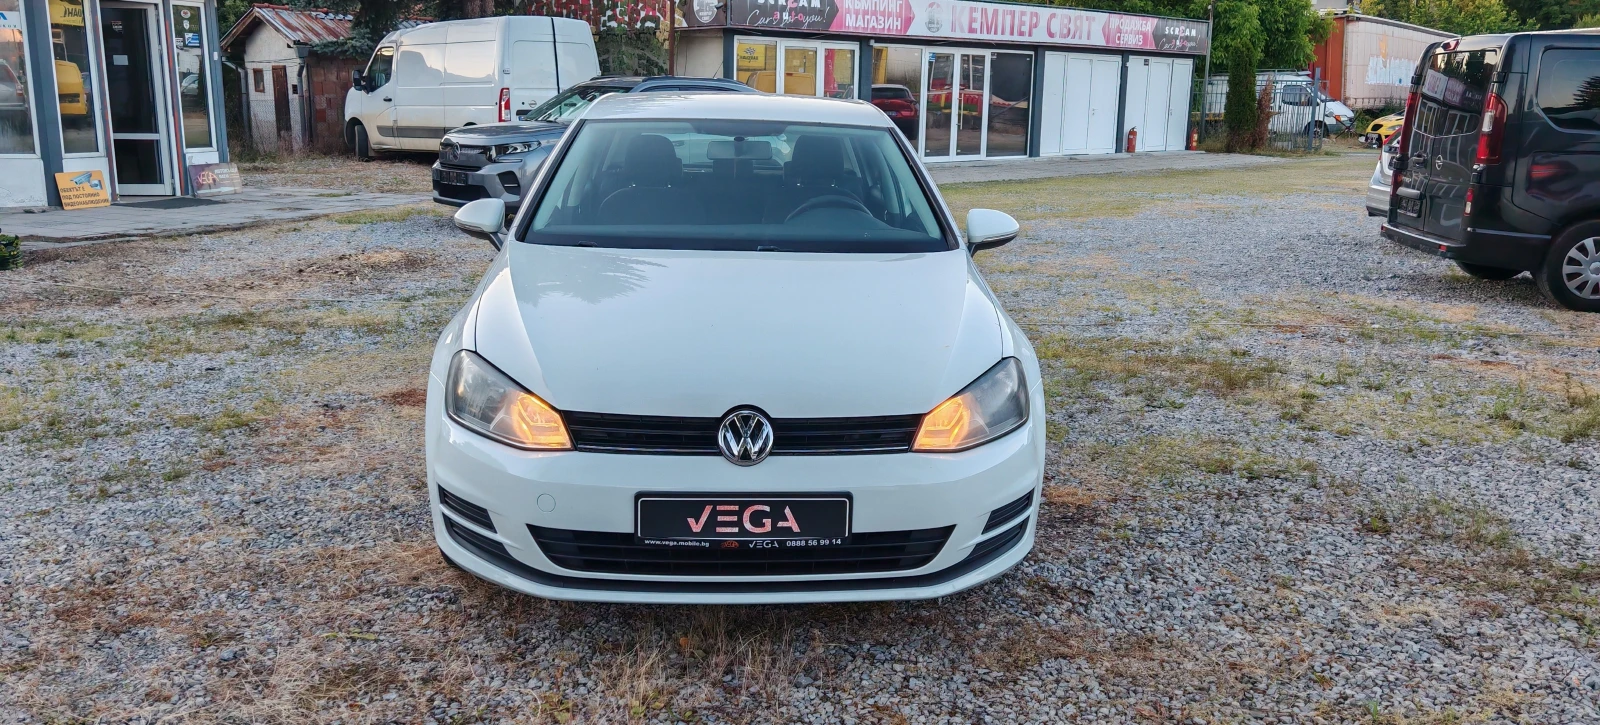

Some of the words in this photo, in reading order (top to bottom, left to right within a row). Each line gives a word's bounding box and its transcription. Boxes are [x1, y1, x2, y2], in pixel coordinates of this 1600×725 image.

[845, 0, 902, 13] КЪМПИНГ
[845, 13, 902, 30] МАГАЗИН
[951, 5, 1040, 37] КЕМПЕР
[1046, 12, 1096, 40] СВЯТ
[1109, 17, 1152, 32] ПРОДАЖБА
[1164, 26, 1197, 37] SCREAM
[1115, 33, 1144, 45] СЕРВИЗ
[687, 505, 801, 533] VEGA
[644, 539, 710, 548] www.vega.mobile.bg
[748, 540, 779, 548] VEGA
